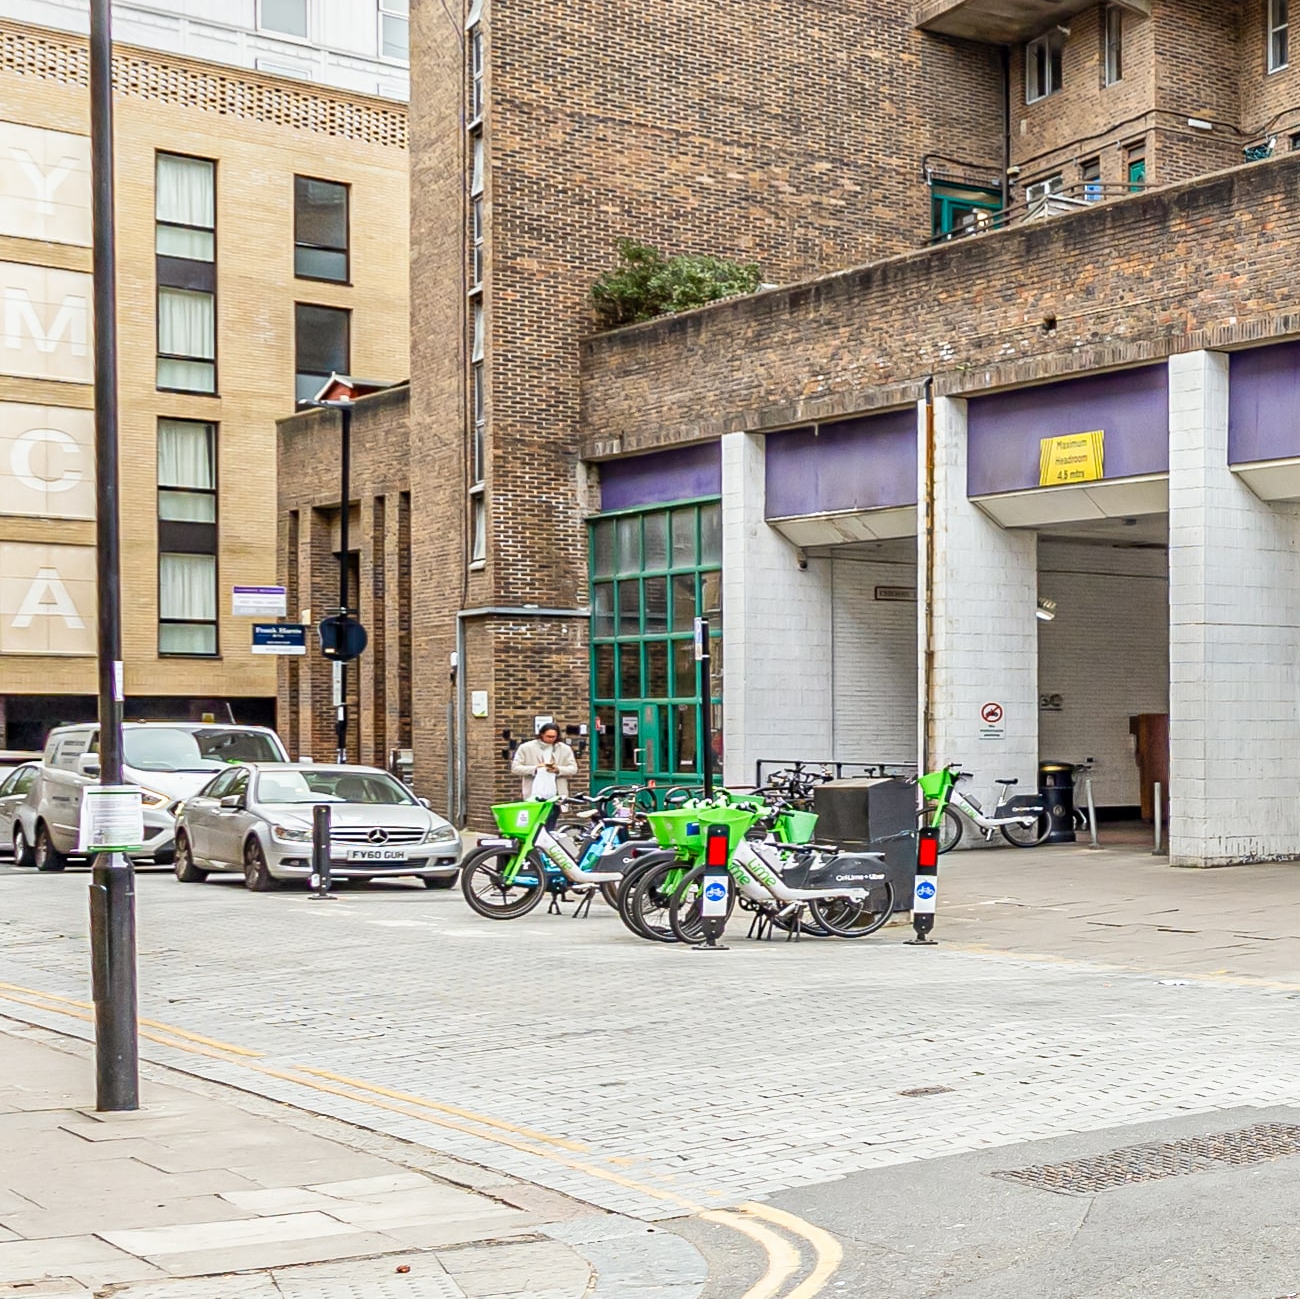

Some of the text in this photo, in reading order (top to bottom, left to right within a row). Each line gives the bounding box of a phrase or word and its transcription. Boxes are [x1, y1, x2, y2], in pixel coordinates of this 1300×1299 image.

[352, 850, 382, 859] FY60
[549, 843, 574, 871] Lime
[747, 857, 777, 887] Lime
